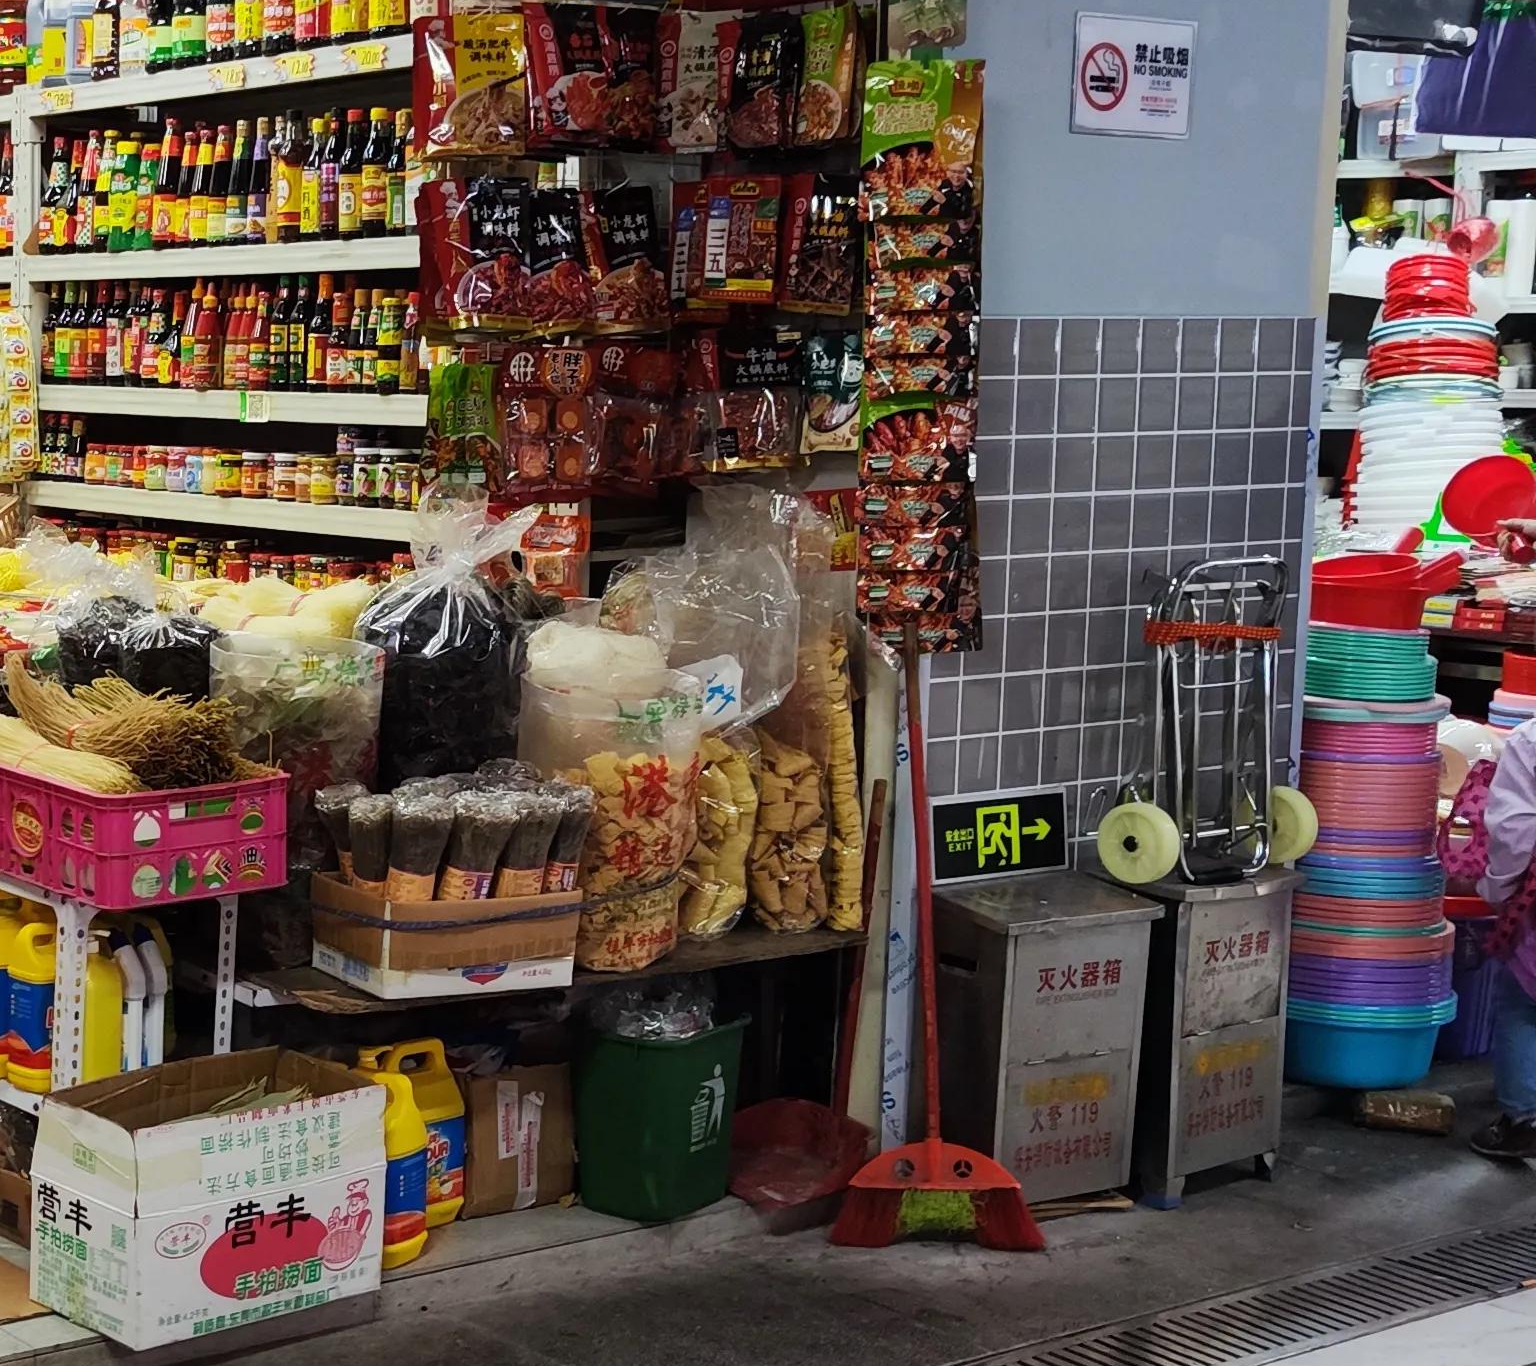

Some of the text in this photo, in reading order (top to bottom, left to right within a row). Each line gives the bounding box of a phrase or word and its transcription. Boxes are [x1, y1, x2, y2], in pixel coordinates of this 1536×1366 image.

[470, 51, 507, 63] 调味料
[1135, 43, 1190, 66] 禁止吸烟
[1133, 65, 1188, 79] NO SMOKING
[480, 205, 521, 222] 小龙虾
[611, 213, 648, 232] 小龙虾
[480, 221, 521, 237] 调味料
[745, 347, 777, 363] 牛油
[736, 363, 790, 376] 火锅底料
[945, 827, 975, 843] 安全出口
[948, 841, 973, 853] EXIT
[1203, 930, 1271, 966] 灭火器箱
[1036, 959, 1123, 993] 灭火器箱
[1229, 1066, 1254, 1092] 119
[1029, 1102, 1100, 1133] 火警 119
[37, 1181, 94, 1237] 营丰
[225, 1193, 312, 1250] 营丰
[34, 1219, 88, 1262] 手拍捞面
[233, 1256, 324, 1301] 手拍捞面
